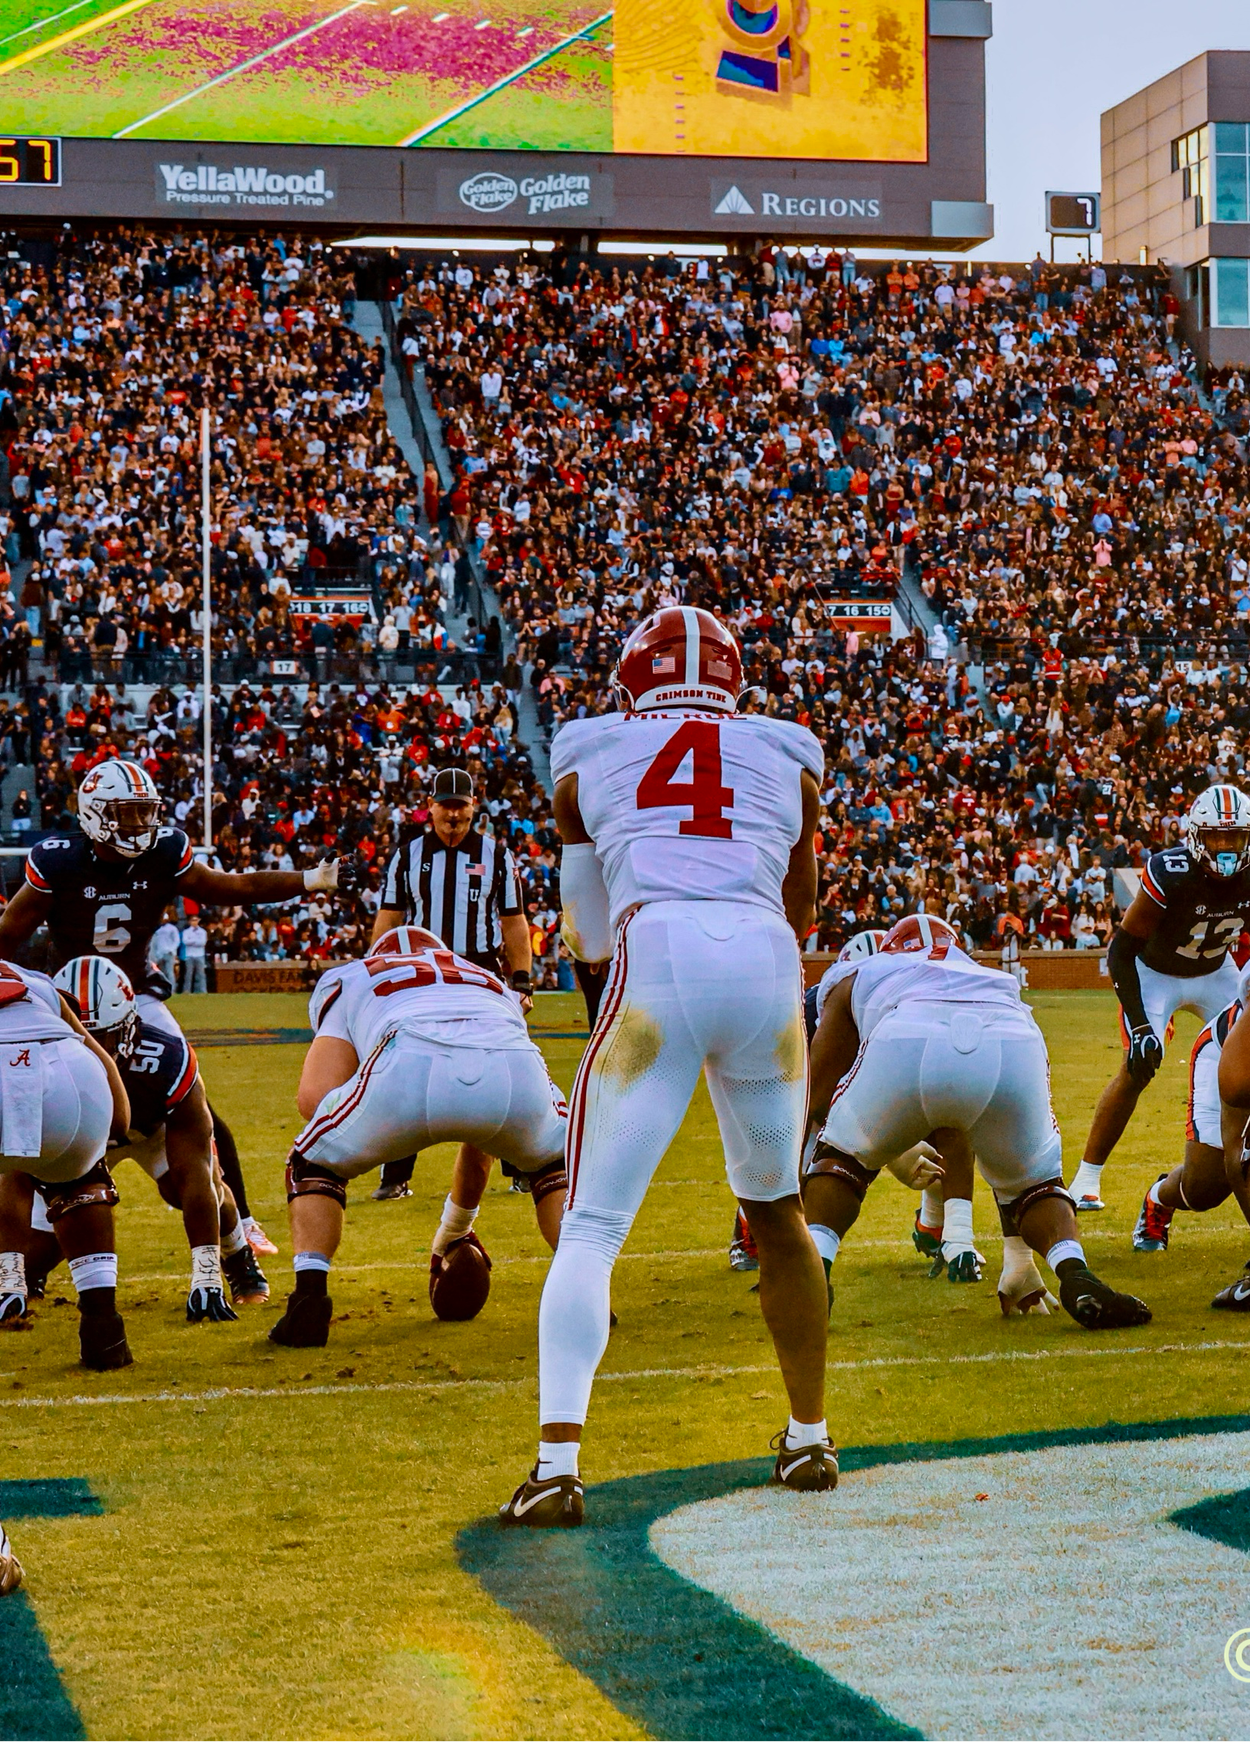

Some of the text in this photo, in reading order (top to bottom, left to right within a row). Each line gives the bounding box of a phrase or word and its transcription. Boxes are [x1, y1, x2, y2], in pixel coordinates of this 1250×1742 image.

[463, 179, 514, 195] Golden
[519, 173, 591, 197] Golden
[166, 191, 325, 207] Pressure Treated Pine
[470, 191, 514, 206] Flake
[528, 190, 589, 215] Flake
[761, 192, 880, 218] REGIONS
[1076, 197, 1093, 226] 7
[319, 602, 336, 613] 17
[843, 605, 860, 616] 16
[277, 663, 292, 672] 17
[655, 689, 727, 703] CRIMSON TIDE
[636, 720, 734, 839] 4
[421, 862, 431, 872] S
[1162, 854, 1190, 873] 13
[98, 893, 131, 902] AUBURN
[469, 888, 479, 902] U
[92, 902, 132, 954] 6
[1175, 917, 1245, 960] 13
